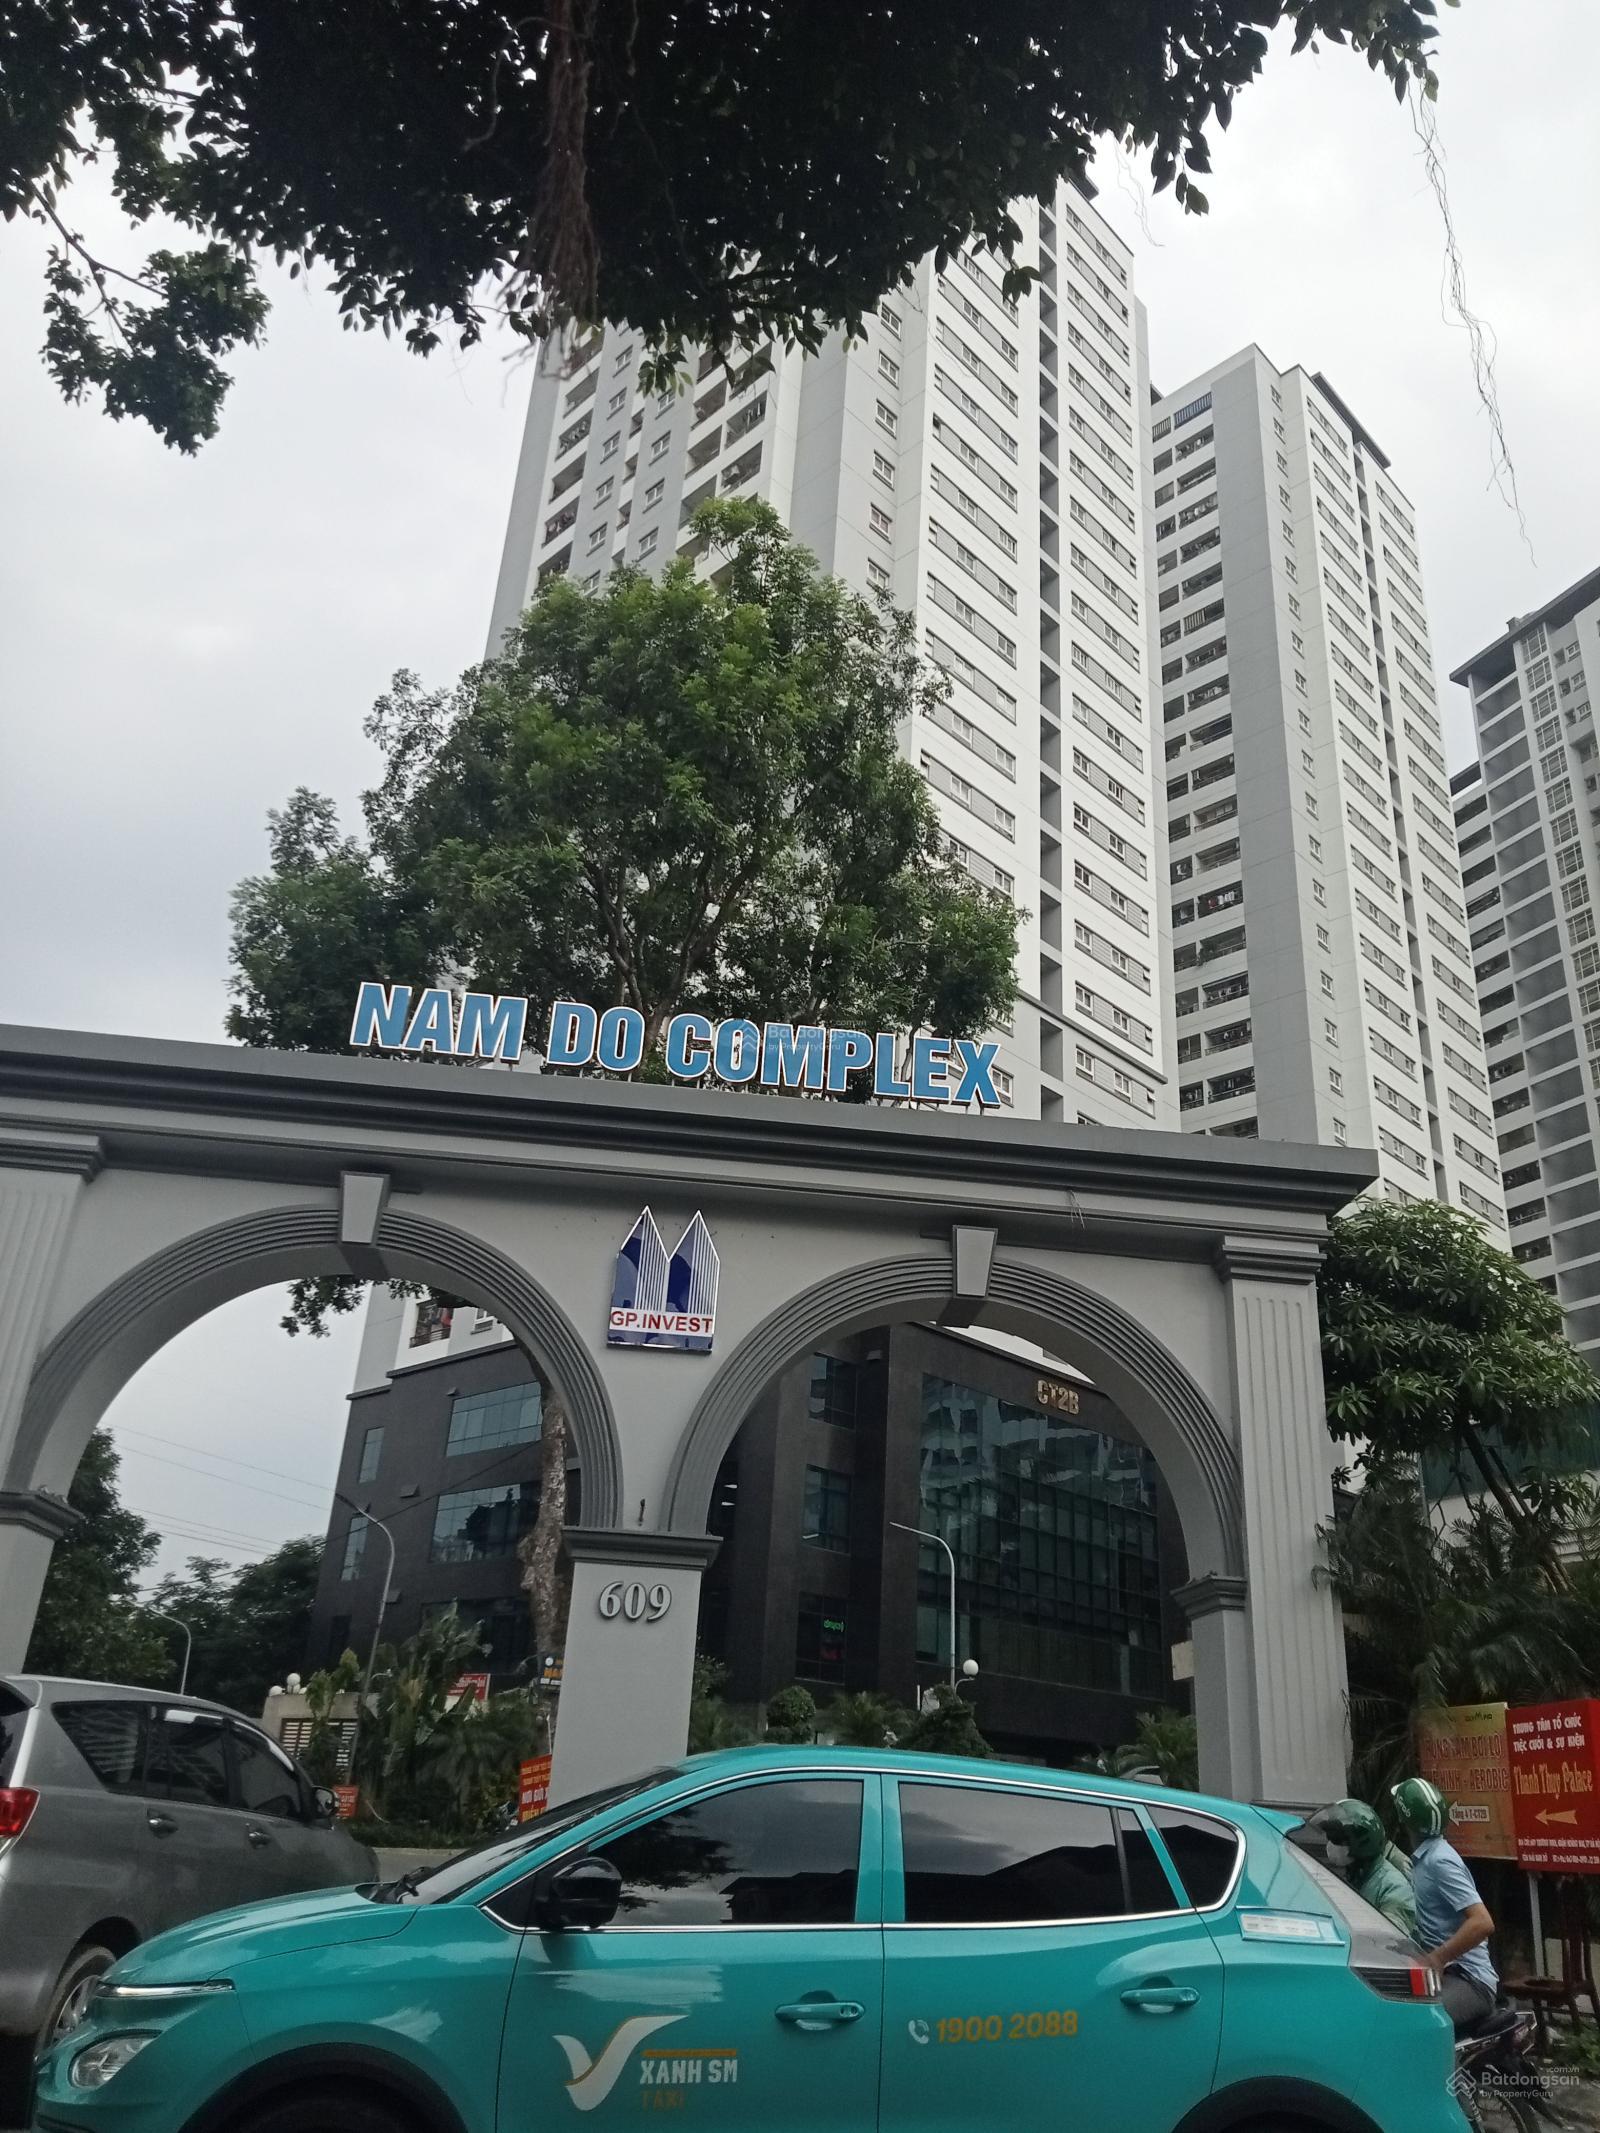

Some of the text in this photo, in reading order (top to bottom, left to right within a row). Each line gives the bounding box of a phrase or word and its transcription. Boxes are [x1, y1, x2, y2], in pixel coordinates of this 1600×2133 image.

[349, 981, 1003, 1108] NAM DO COMPLEX
[610, 1310, 714, 1334] GP.INVEST
[599, 1580, 673, 1622] 609
[936, 2009, 1079, 2044] 1900 2088
[639, 2059, 738, 2084] XANH SM
